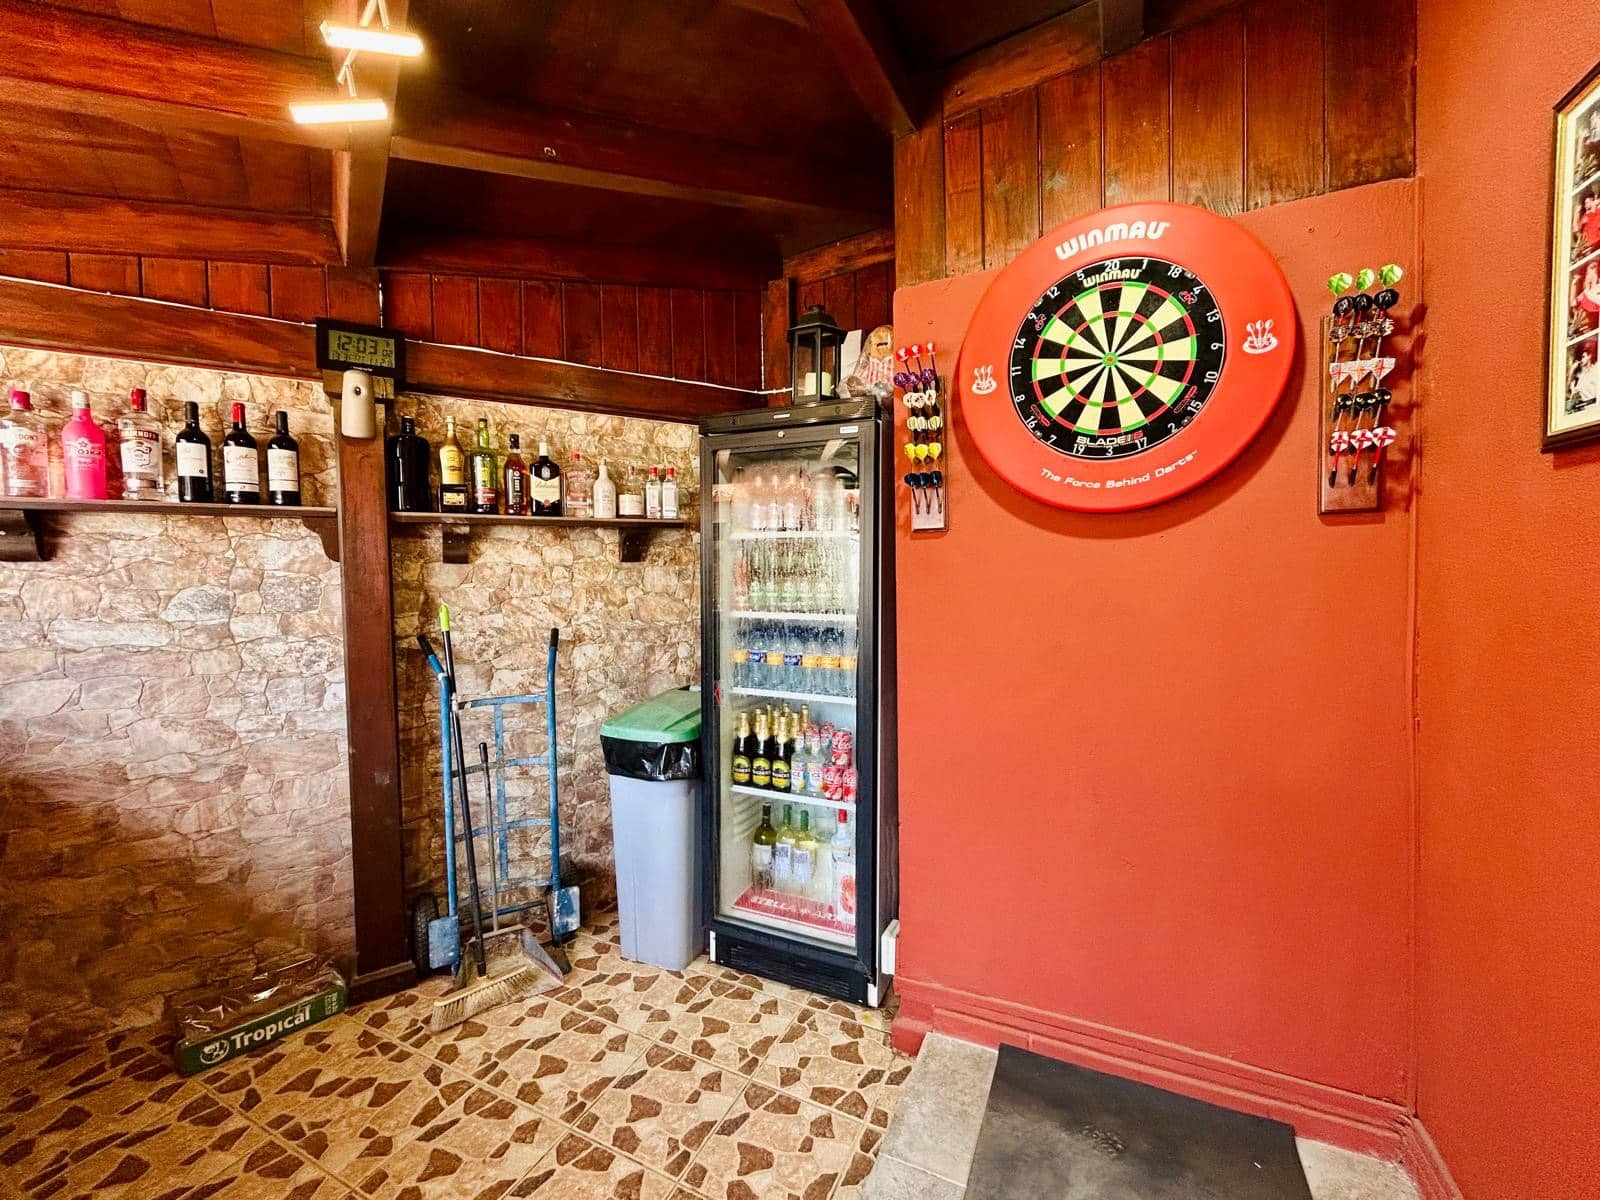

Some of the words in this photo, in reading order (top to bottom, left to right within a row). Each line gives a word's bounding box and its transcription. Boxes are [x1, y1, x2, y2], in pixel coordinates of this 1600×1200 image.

[1055, 220, 1171, 261] WINMAU
[1104, 259, 1120, 273] 20
[1167, 264, 1183, 279] 18
[1076, 269, 1085, 281] 5
[1082, 268, 1142, 288] WINMAU
[1046, 286, 1061, 299] 12
[1192, 285, 1205, 295] 4
[1206, 308, 1220, 323] 13
[1014, 337, 1027, 349] 14
[1011, 366, 1022, 377] 11
[1203, 370, 1219, 384] 10
[1015, 394, 1026, 403] 8
[1187, 399, 1202, 413] 15
[1026, 415, 1038, 429] 16
[1167, 422, 1177, 433] 2
[1047, 434, 1057, 444] 7
[1135, 436, 1148, 449] 17
[1073, 443, 1085, 455] 19
[1105, 445, 1113, 456] 3
[1041, 468, 1061, 482] The
[1064, 477, 1101, 489] Force
[1105, 473, 1150, 489] Behind
[230, 1003, 312, 1049] Tropical
